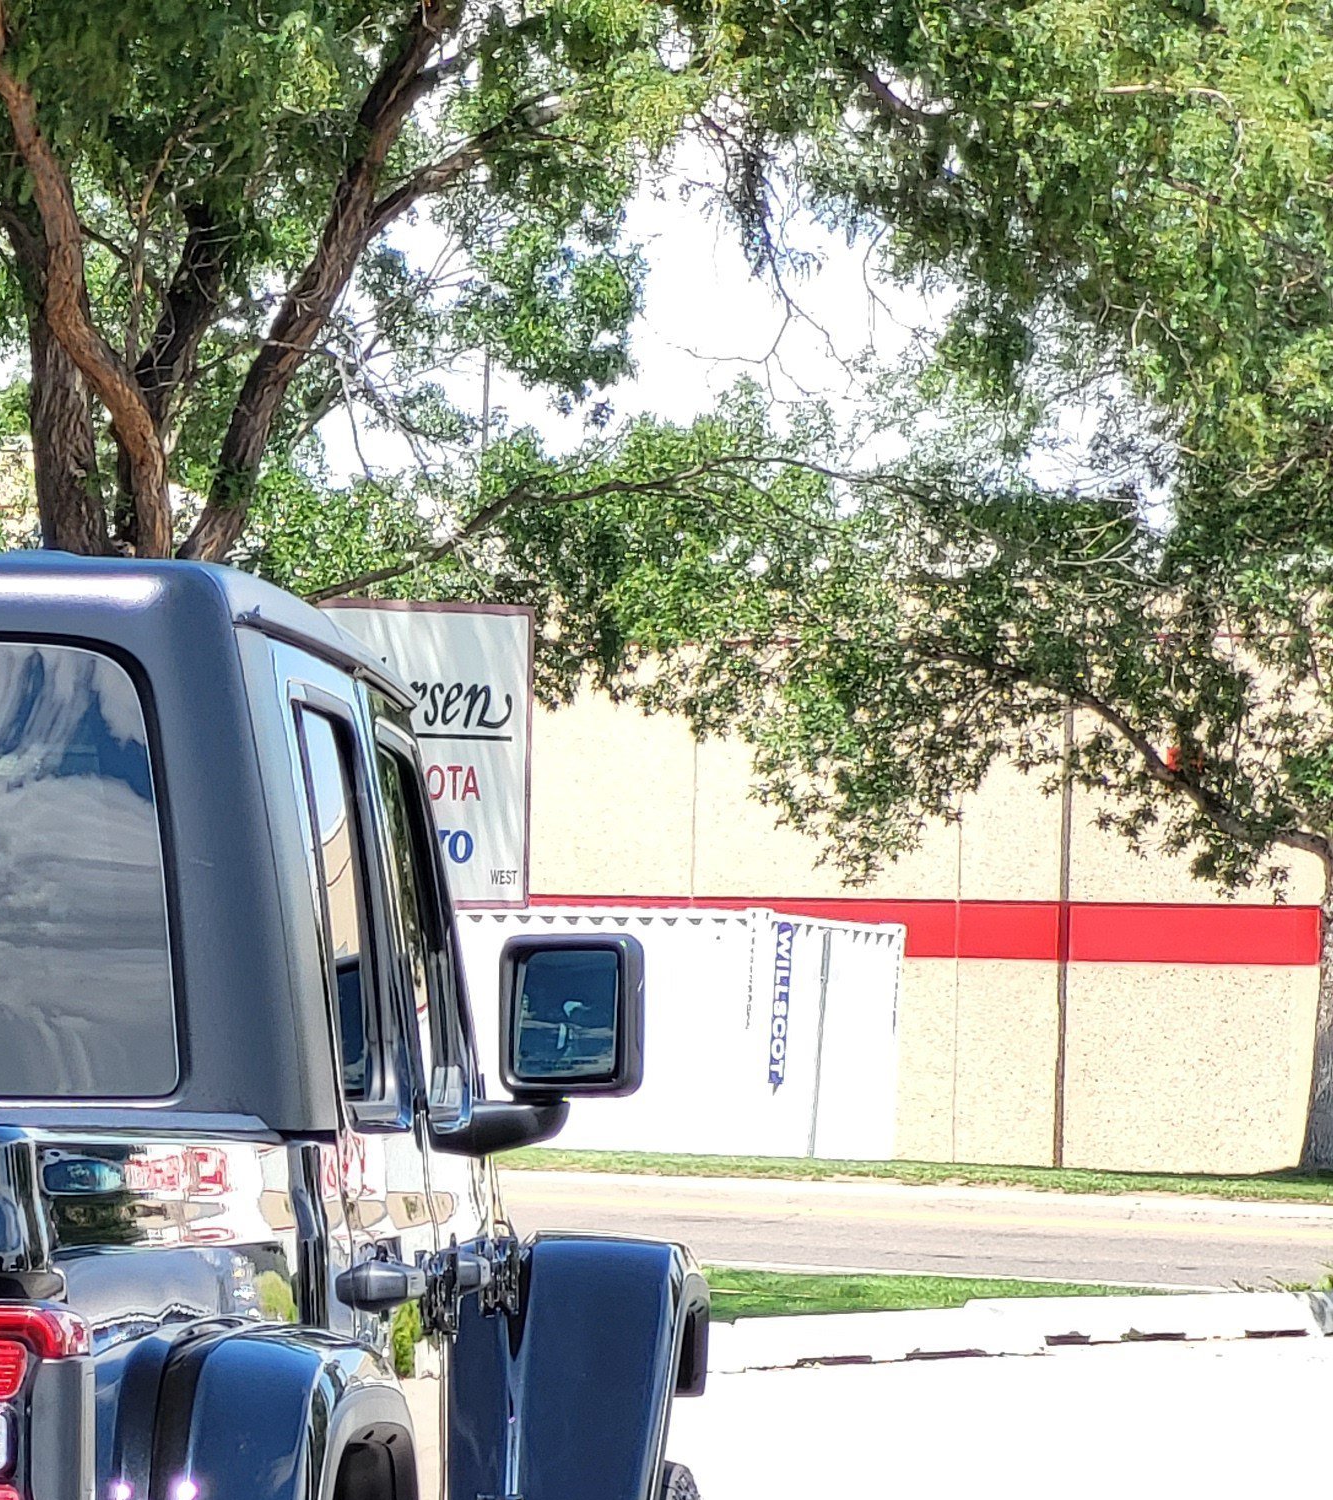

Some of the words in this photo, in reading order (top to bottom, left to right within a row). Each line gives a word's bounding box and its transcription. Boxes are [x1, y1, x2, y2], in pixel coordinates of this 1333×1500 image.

[426, 765, 481, 801] OTA
[490, 870, 517, 885] WEST
[769, 928, 793, 1078] WILLSCOT
